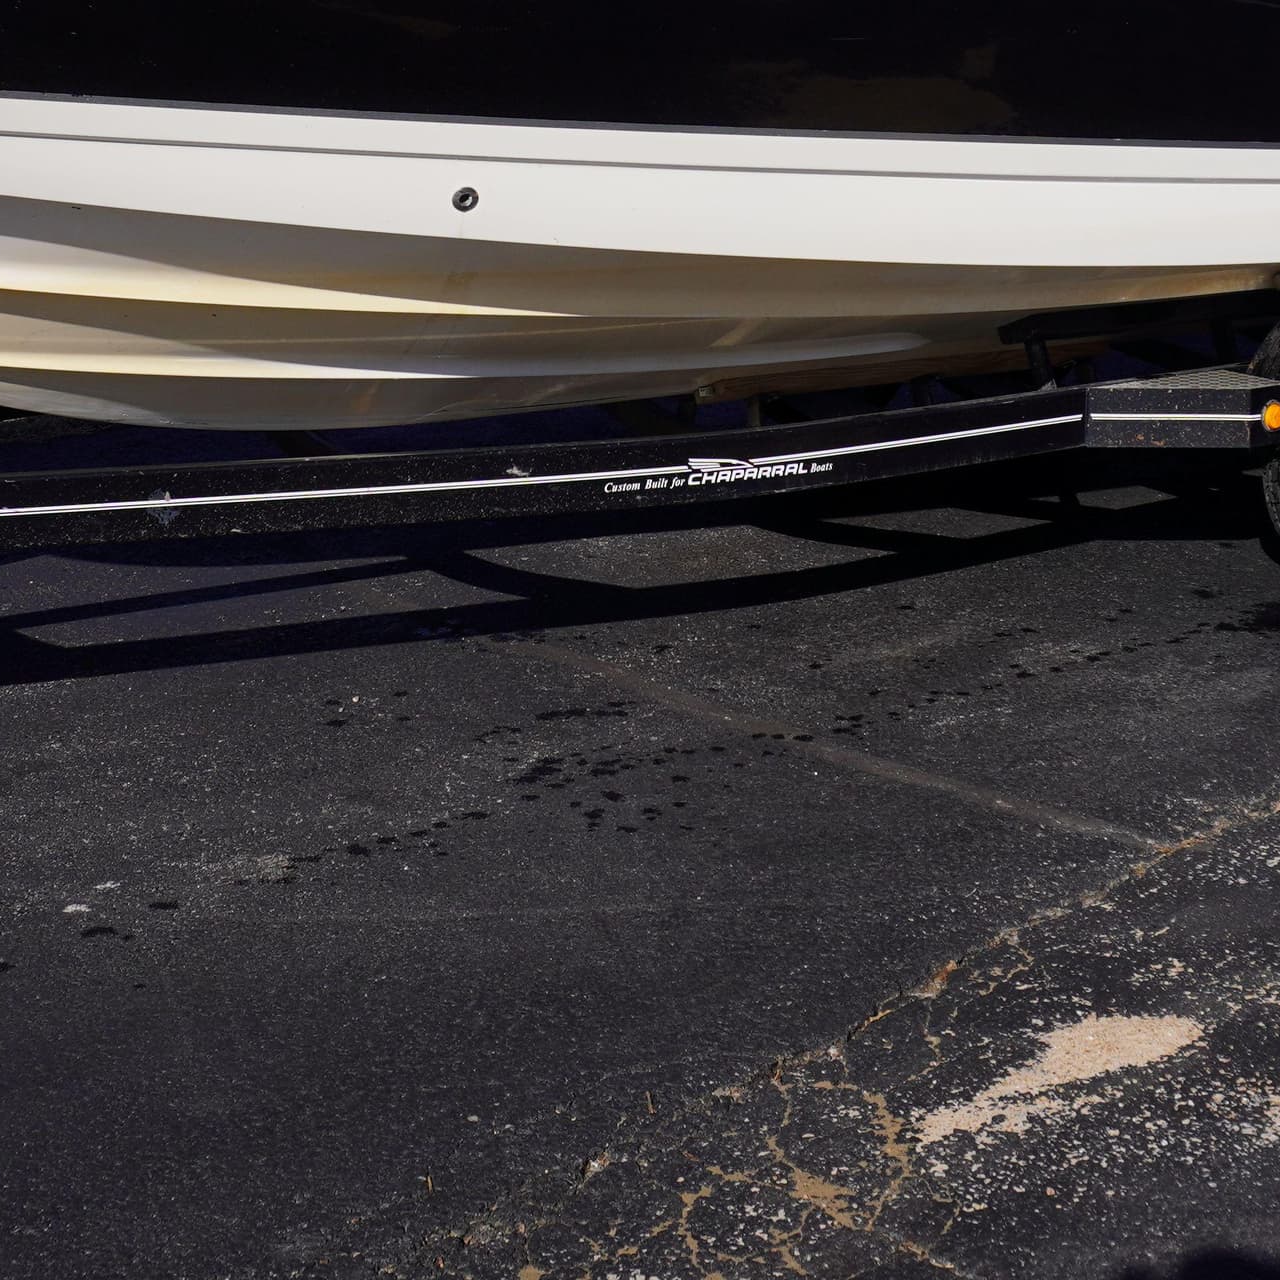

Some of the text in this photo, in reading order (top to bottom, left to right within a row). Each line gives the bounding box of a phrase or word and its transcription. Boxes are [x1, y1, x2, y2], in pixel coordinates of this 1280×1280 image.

[604, 462, 834, 493] Custom Built for CHAPARRAL Boats
